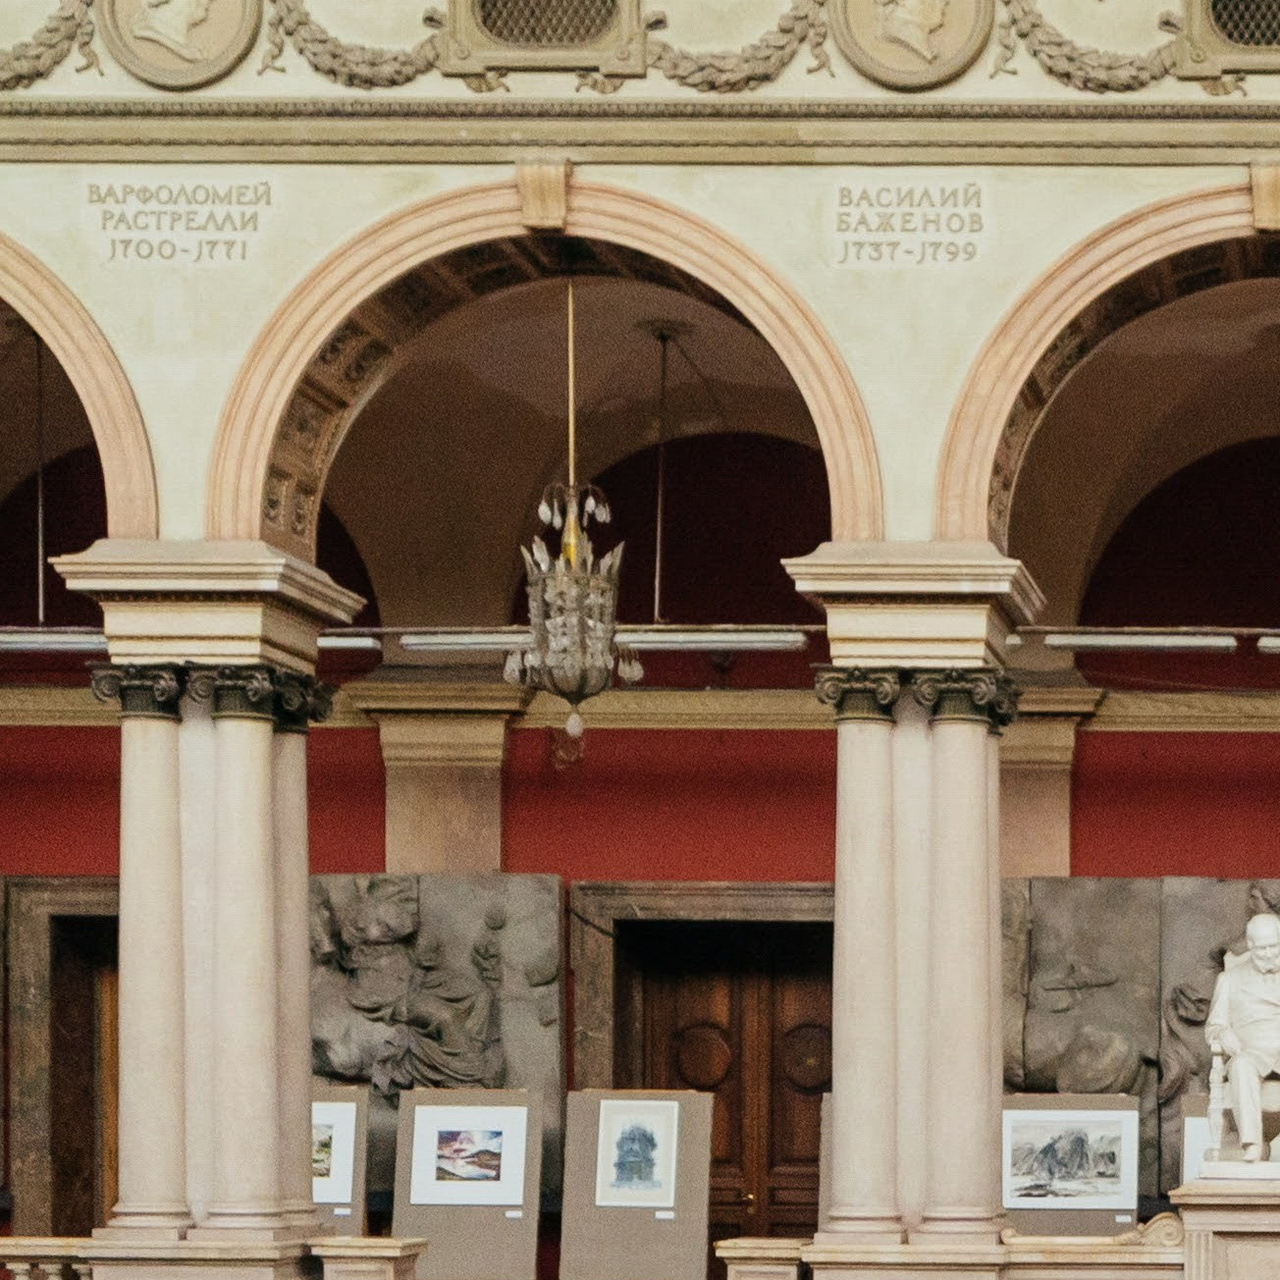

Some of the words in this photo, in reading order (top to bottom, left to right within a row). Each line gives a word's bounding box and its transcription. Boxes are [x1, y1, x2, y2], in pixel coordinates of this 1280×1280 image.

[87, 181, 272, 206] ВАРФОЛОМЕЙ
[838, 182, 982, 208] ВАСИЛИЙ
[101, 209, 259, 232] РАСТРЕЛЛИ
[836, 212, 984, 233] БАЖЕНОВ
